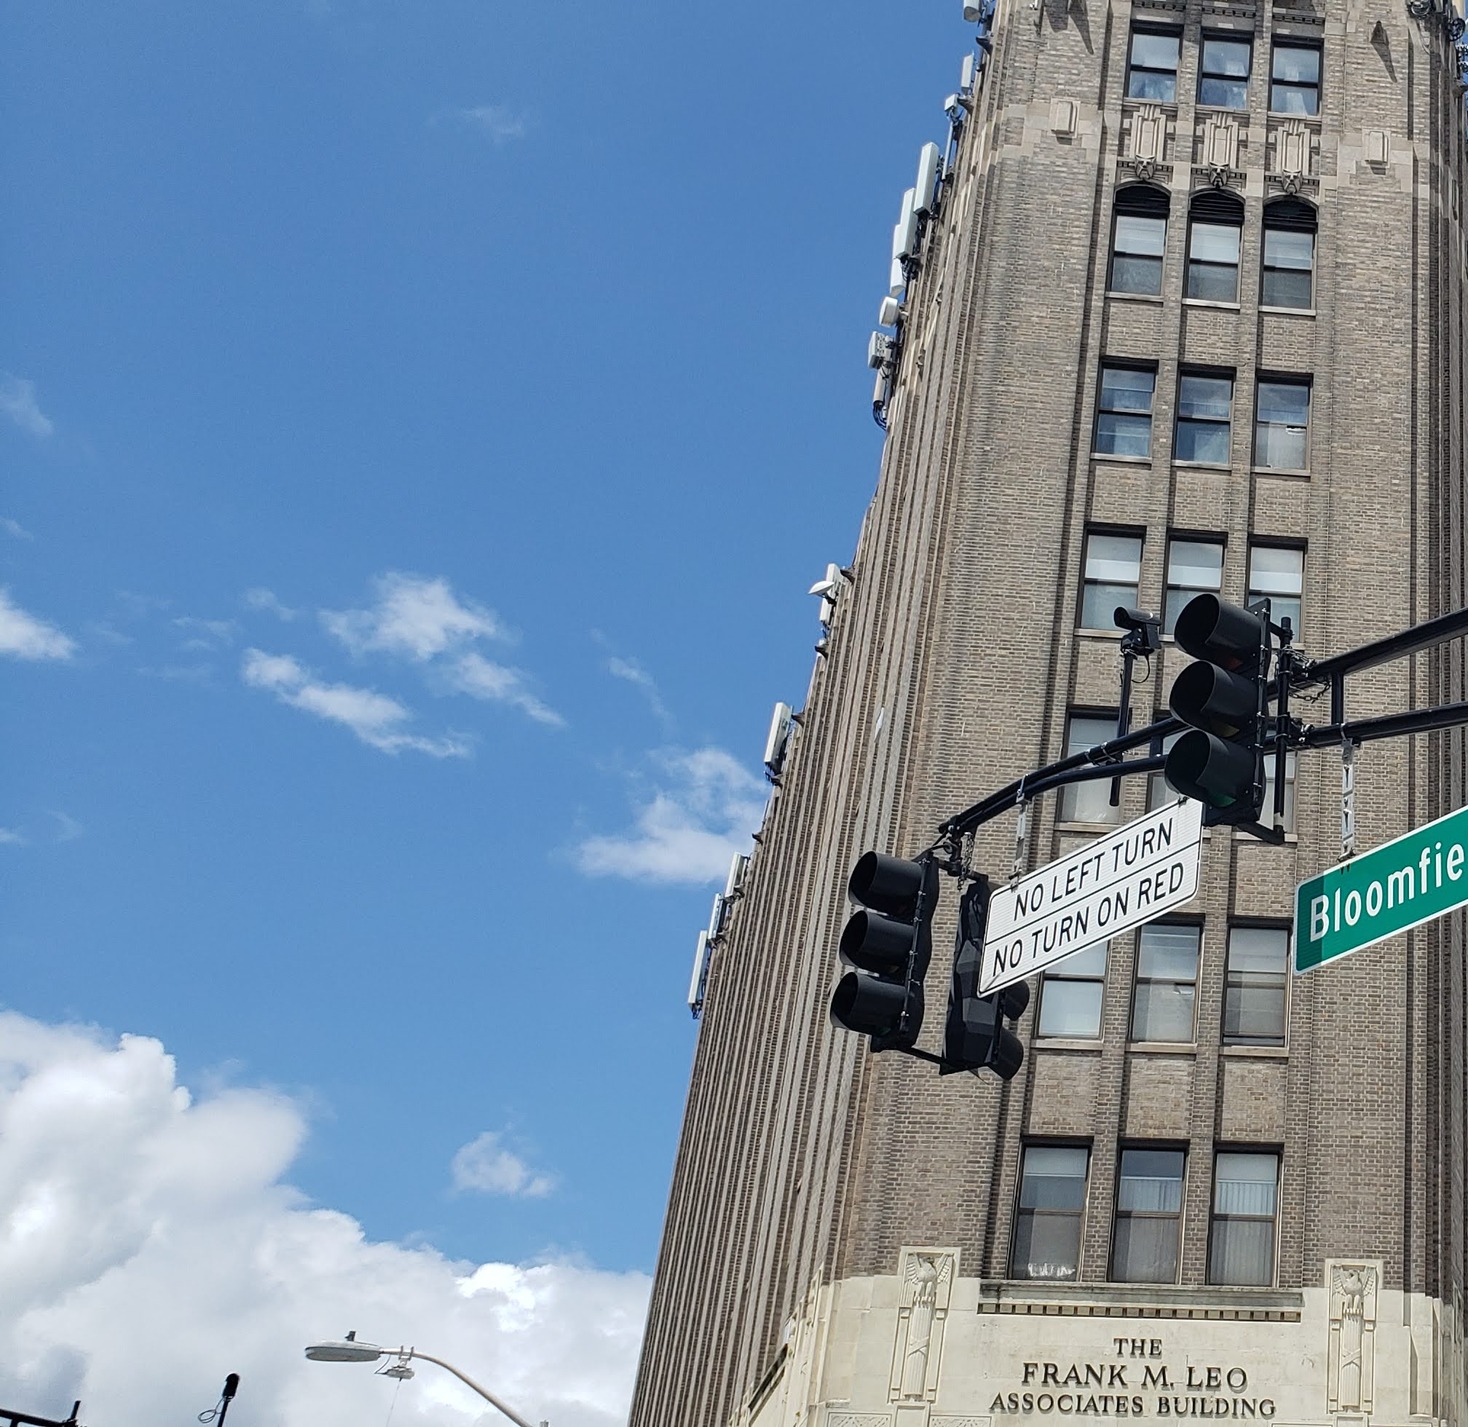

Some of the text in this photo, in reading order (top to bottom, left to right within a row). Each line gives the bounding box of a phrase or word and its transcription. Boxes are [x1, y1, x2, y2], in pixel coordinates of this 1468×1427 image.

[1014, 818, 1173, 921] NO LEFT TURN
[993, 862, 1184, 977] NO TURN ON RED
[1113, 1338, 1162, 1357] THE
[1021, 1362, 1247, 1391] FRANK M. LEO
[989, 1391, 1275, 1419] ASSOCIATES BUILDING
